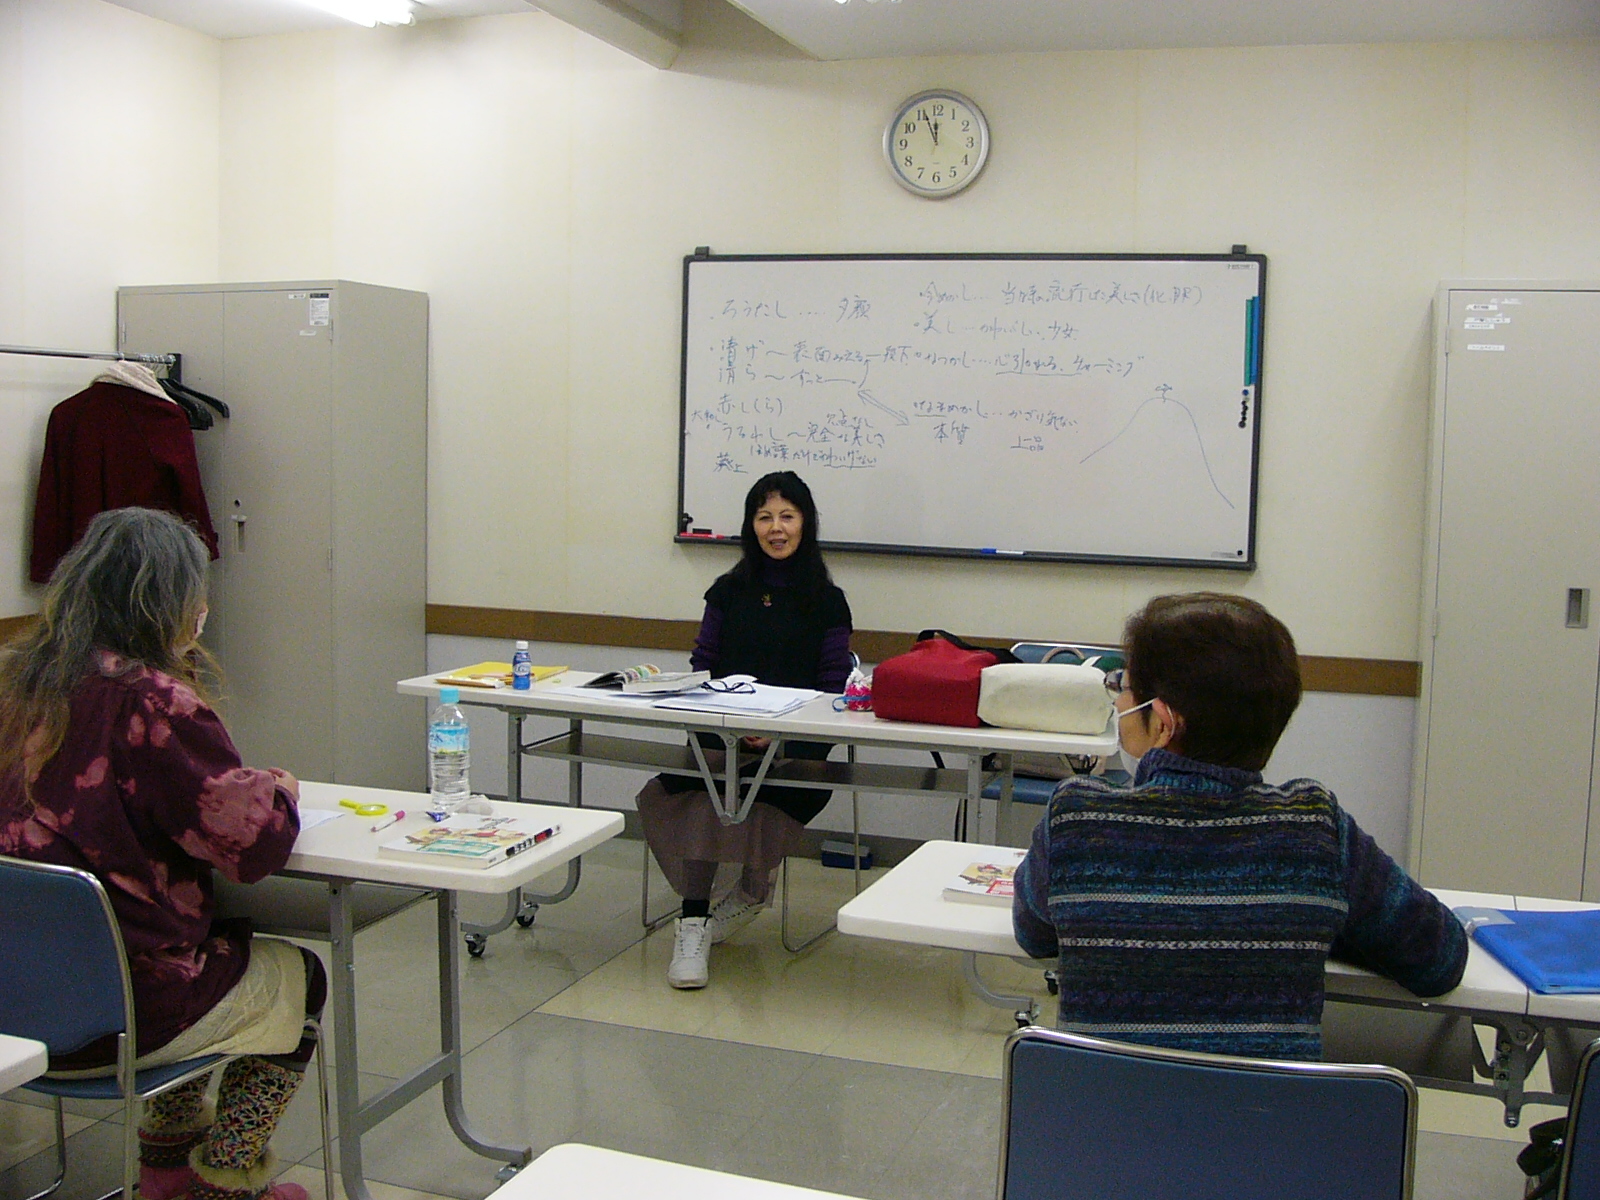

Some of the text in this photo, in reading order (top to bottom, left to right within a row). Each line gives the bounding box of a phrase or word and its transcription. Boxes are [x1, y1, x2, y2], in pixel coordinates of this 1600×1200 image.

[932, 104, 944, 117] 12
[951, 108, 956, 120] 1
[904, 122, 916, 134] 10
[962, 120, 970, 132] 2
[899, 139, 908, 151] 9
[966, 137, 974, 149] 3
[904, 156, 913, 167] 8
[961, 154, 969, 166] 4
[917, 167, 925, 179] 7
[932, 172, 941, 183] 6
[949, 166, 957, 178] 5
